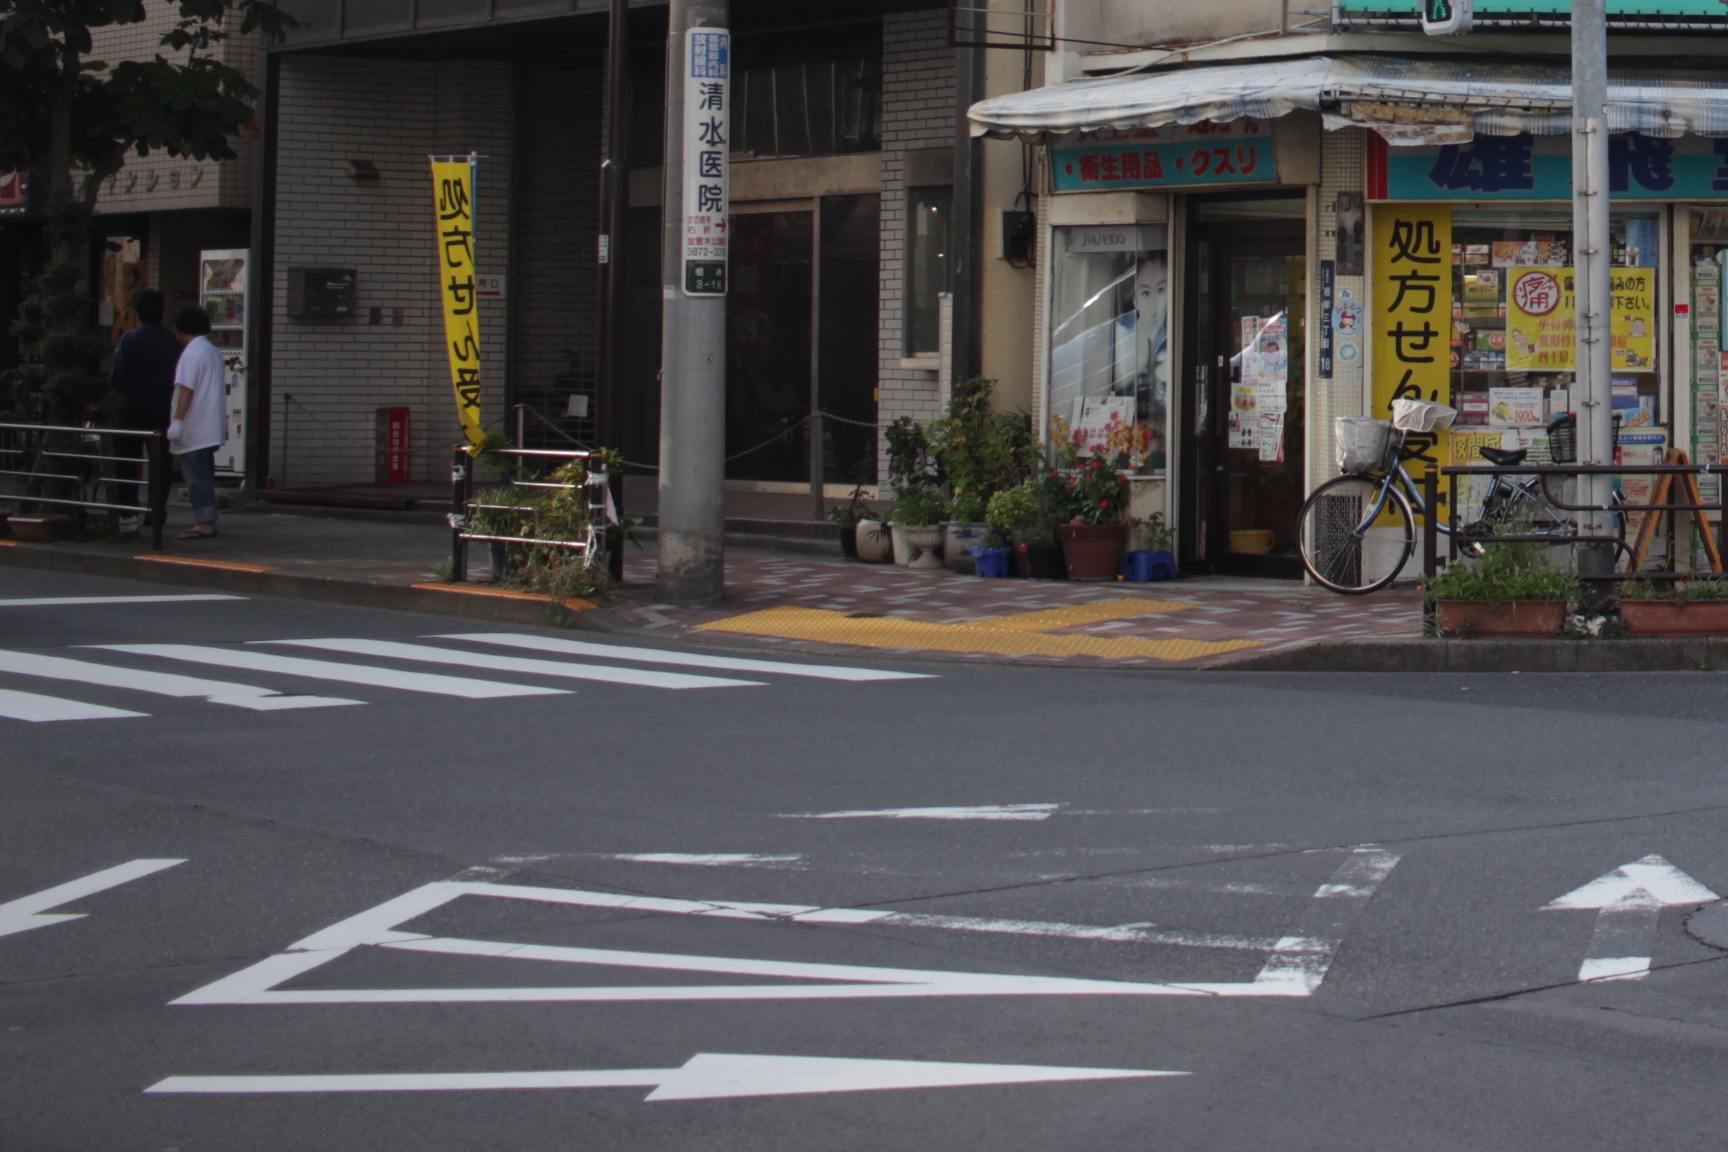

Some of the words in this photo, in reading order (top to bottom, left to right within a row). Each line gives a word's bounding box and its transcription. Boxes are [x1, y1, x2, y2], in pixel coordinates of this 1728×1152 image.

[698, 81, 724, 213] 清水医院
[1080, 233, 1126, 247] SHISEIDO
[1320, 357, 1331, 371] 18
